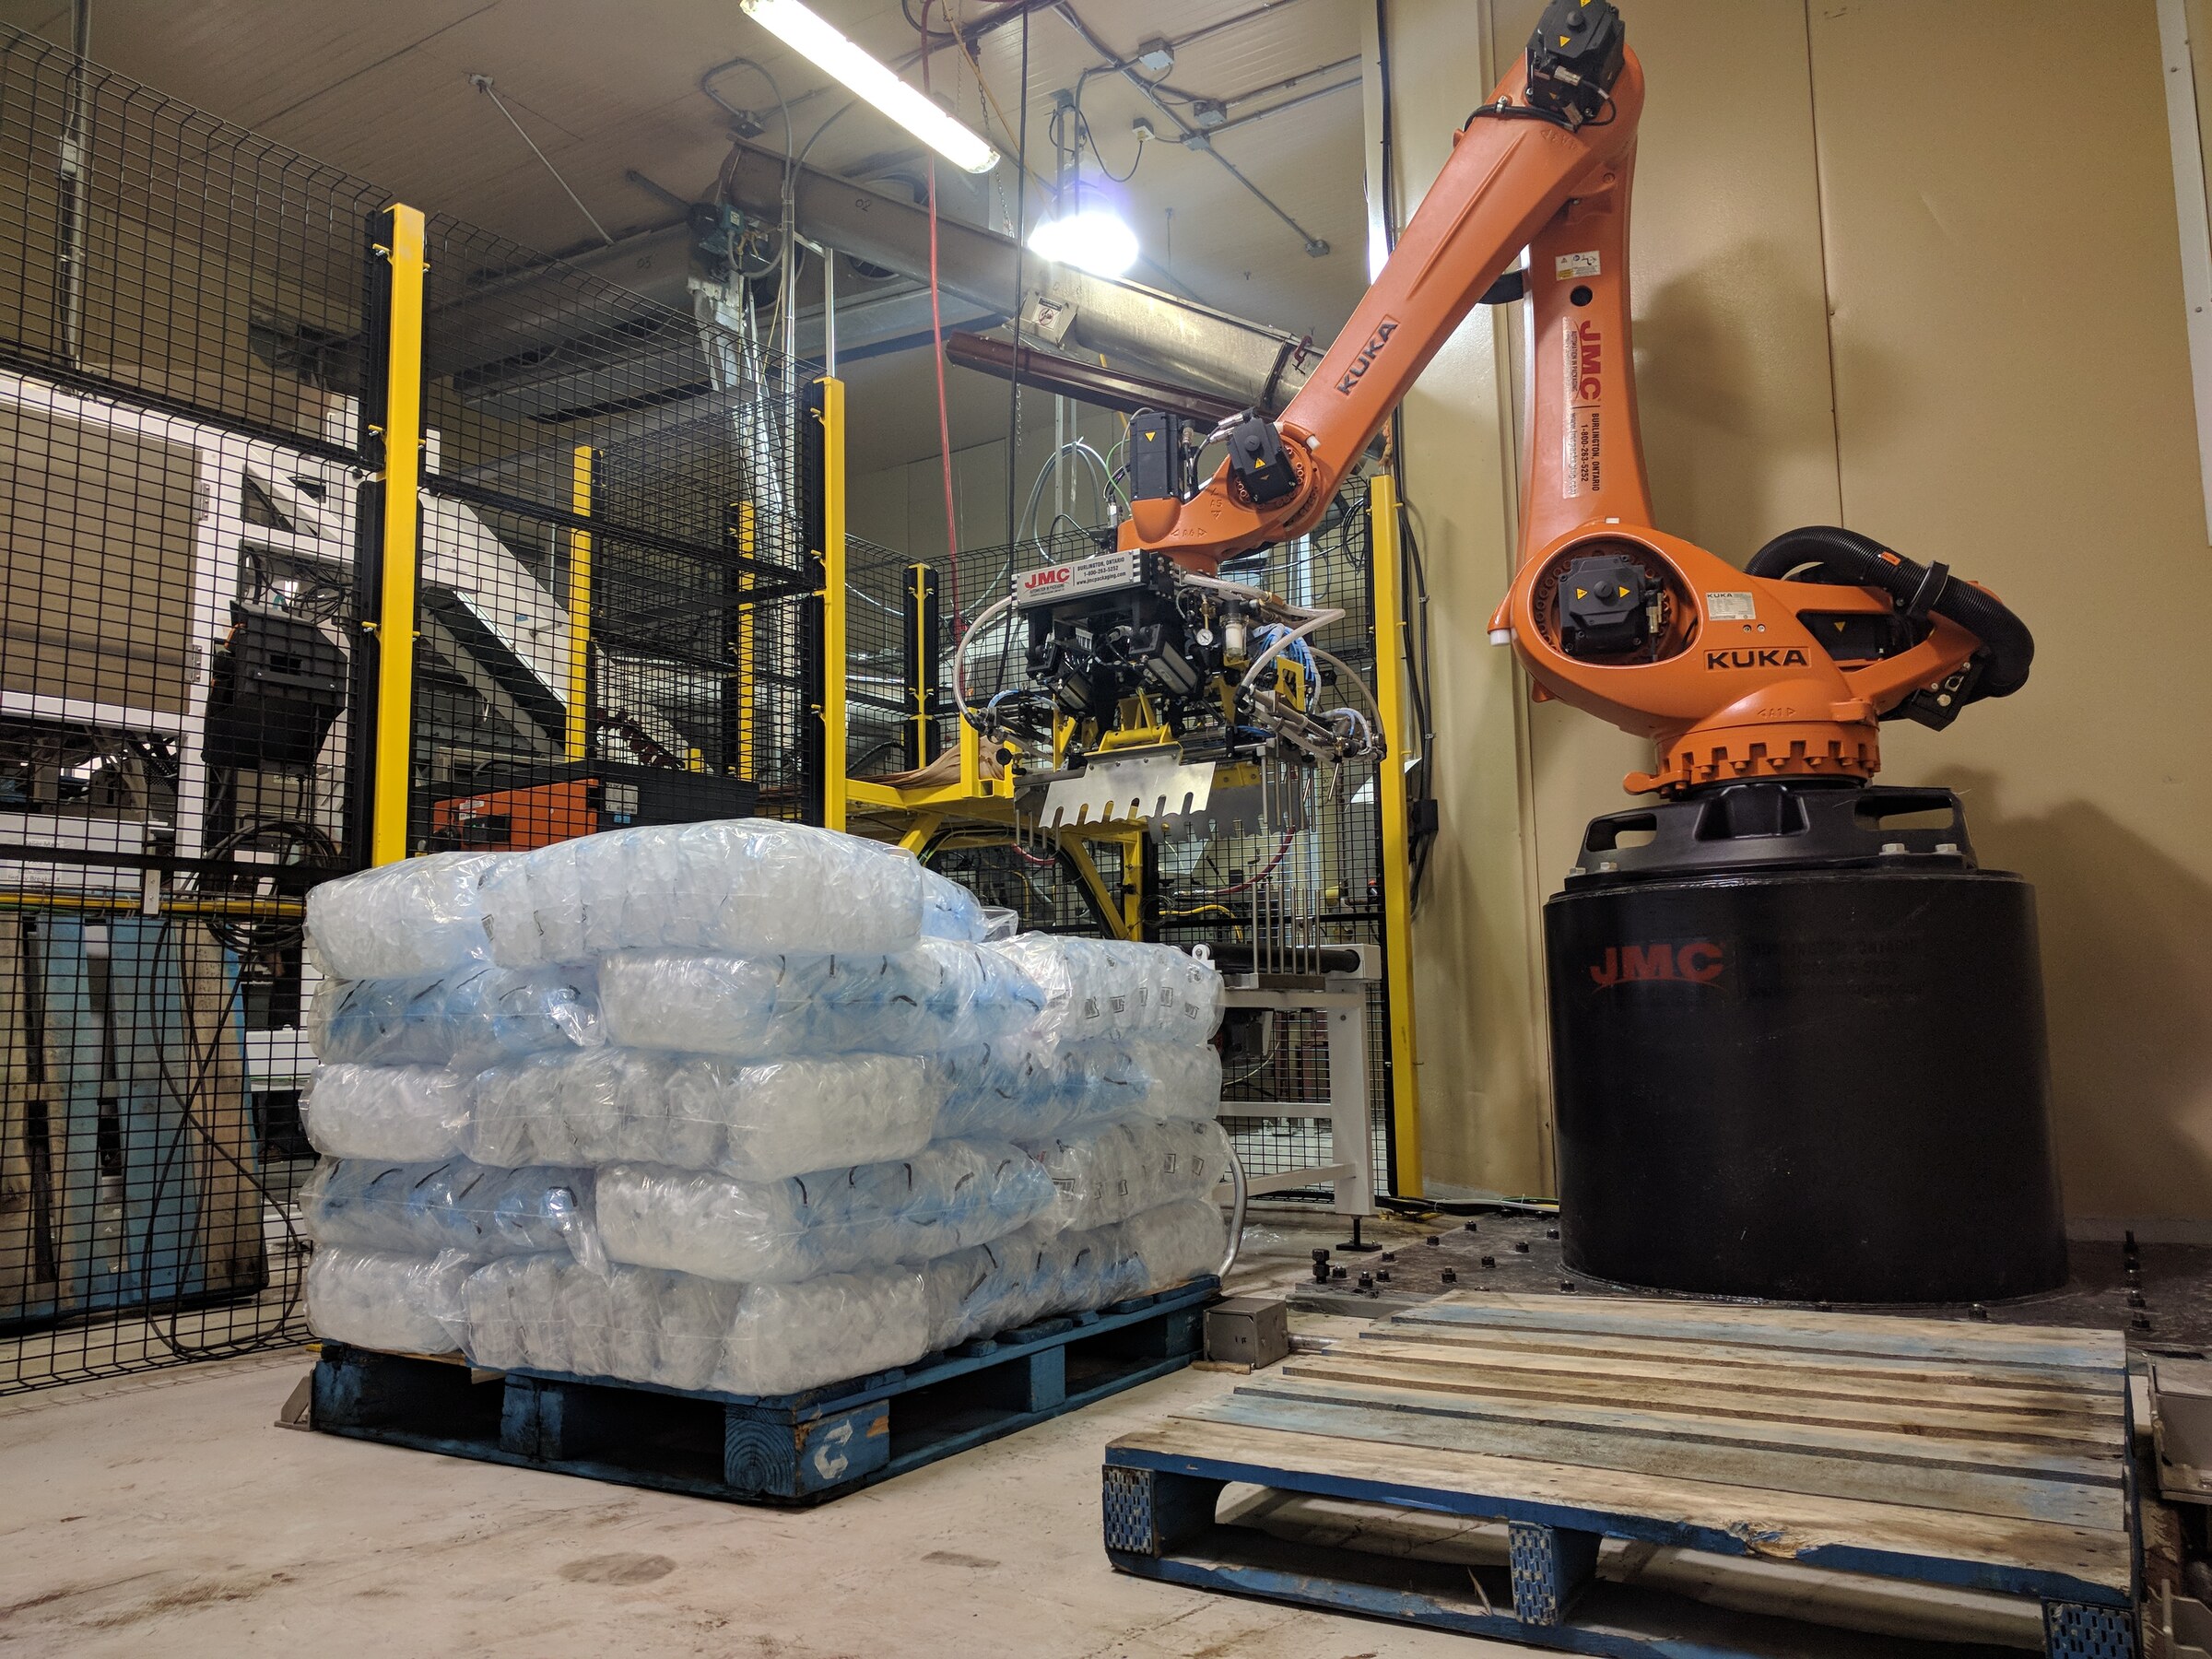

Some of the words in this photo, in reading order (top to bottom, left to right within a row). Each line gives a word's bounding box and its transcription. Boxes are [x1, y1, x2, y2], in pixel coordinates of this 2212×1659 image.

[1336, 324, 1398, 396] KUKA
[1580, 321, 1602, 400] JMC
[1581, 424, 1589, 482] 1-800-263-5252
[1591, 412, 1600, 460] BURLINGTON,
[1592, 461, 1600, 491] ONTARIO
[1025, 568, 1070, 589] JMC
[1106, 557, 1125, 566] ONTARIO
[1707, 650, 1807, 670] KUKA
[1590, 942, 1724, 985] JMC
